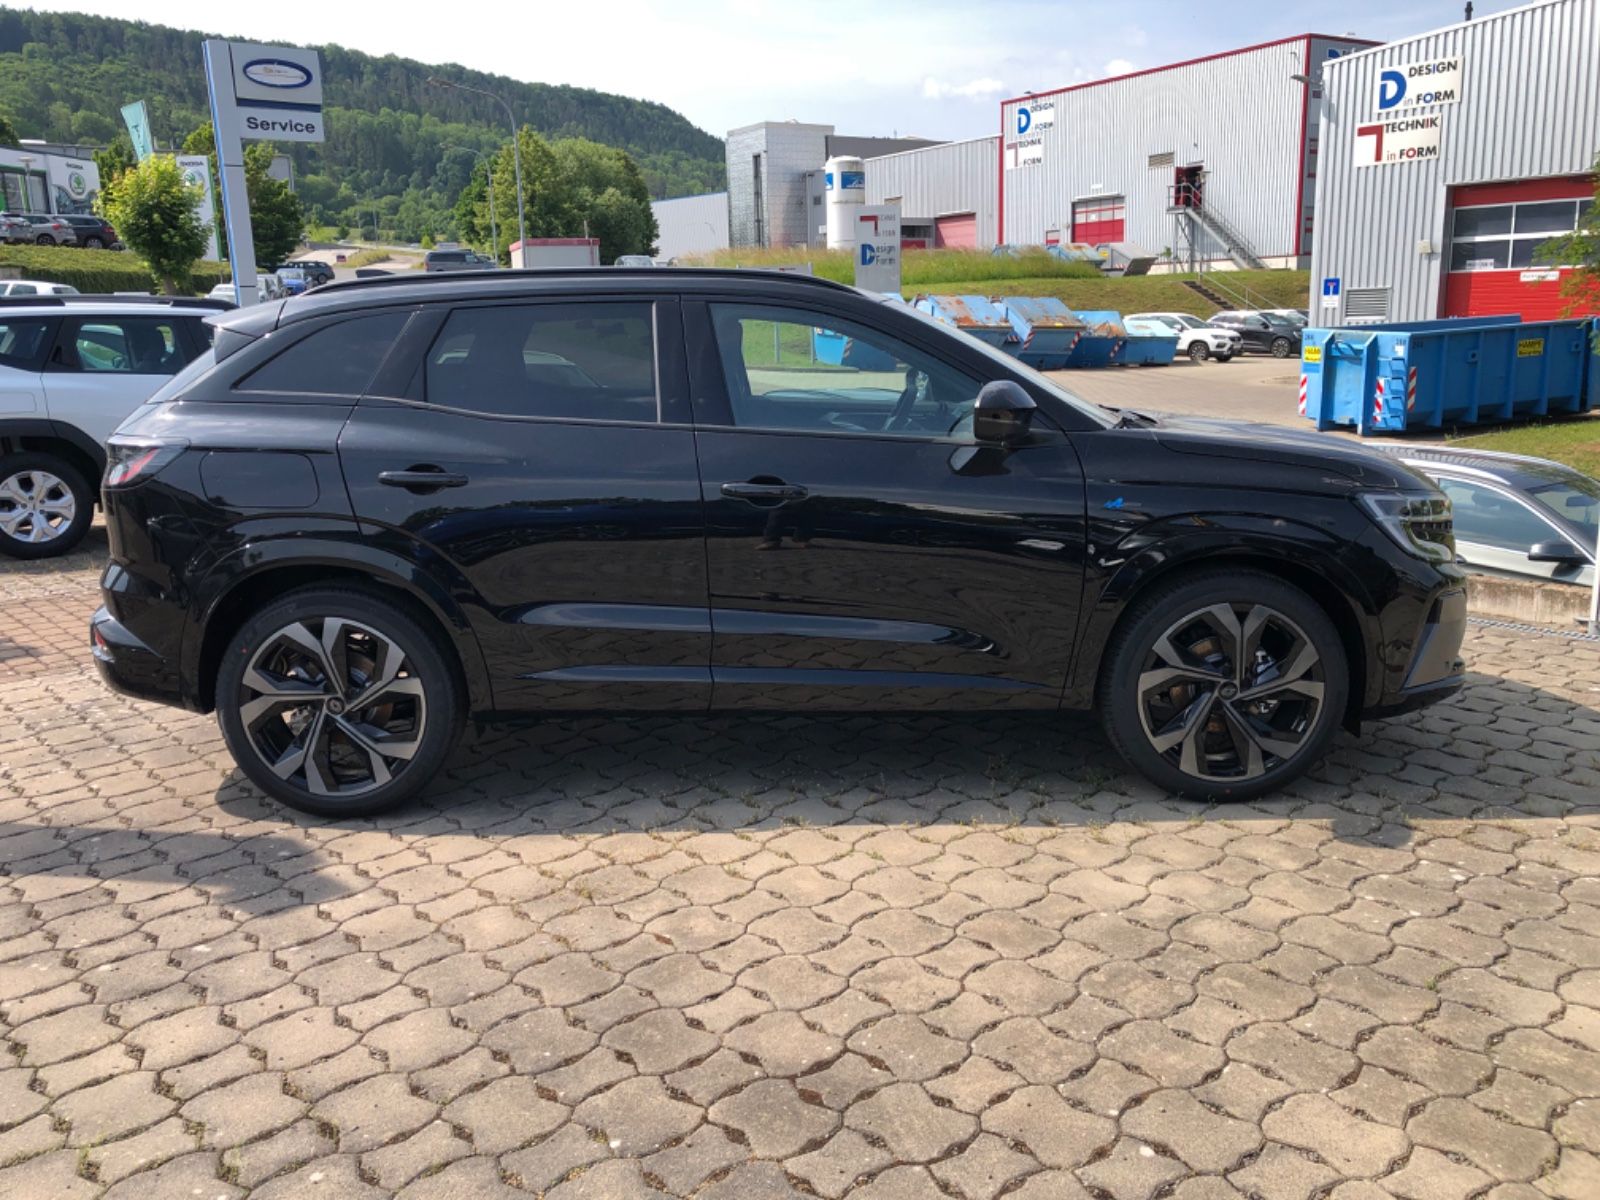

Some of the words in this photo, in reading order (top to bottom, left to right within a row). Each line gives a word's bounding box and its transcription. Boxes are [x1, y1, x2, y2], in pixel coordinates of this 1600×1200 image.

[1408, 60, 1458, 78] DESIGN
[1416, 90, 1455, 105] FORM
[246, 116, 316, 134] Service
[1385, 116, 1439, 133] TECHNIK
[1400, 145, 1437, 159] FORM
